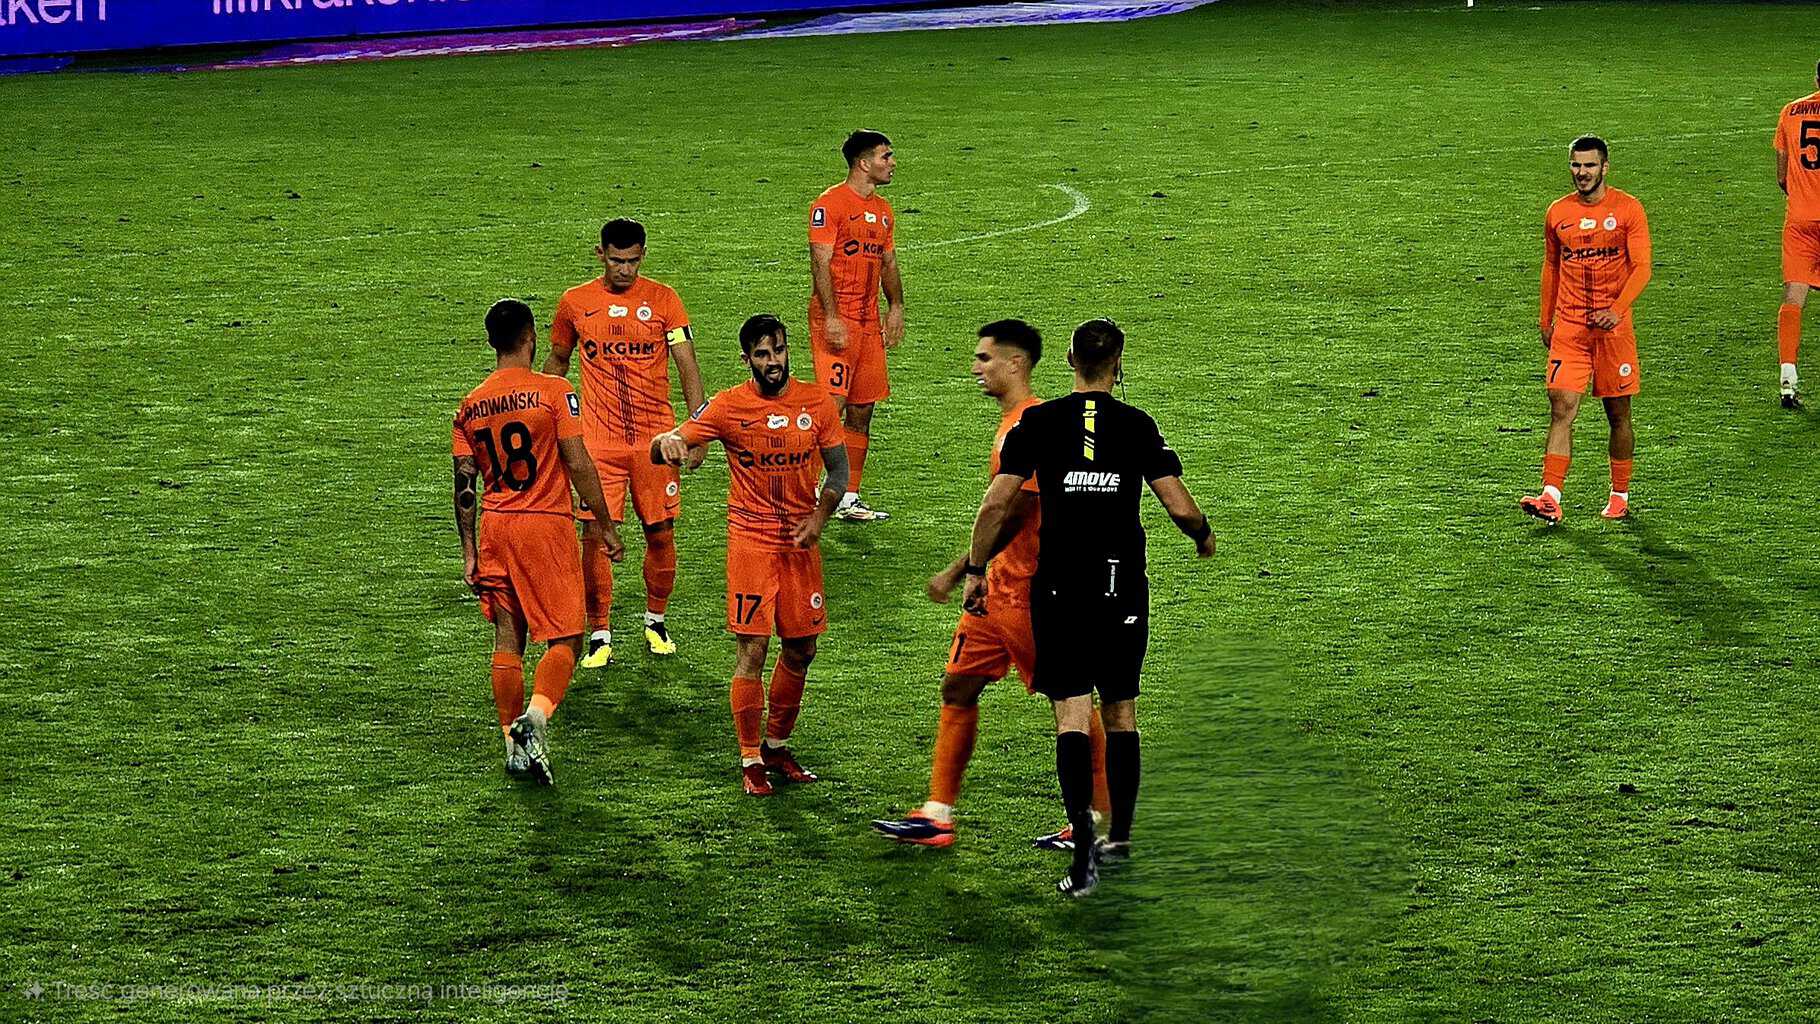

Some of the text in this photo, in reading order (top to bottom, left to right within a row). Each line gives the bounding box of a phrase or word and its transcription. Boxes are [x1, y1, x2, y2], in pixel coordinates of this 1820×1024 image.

[1800, 120, 1820, 170] 5
[602, 341, 654, 355] KGHM
[829, 361, 850, 390] 31
[1550, 359, 1562, 383] 7
[464, 389, 540, 421] RADWAŃSKI
[473, 421, 538, 493] 18
[1063, 471, 1120, 486] 4MOVE
[735, 593, 763, 624] 17
